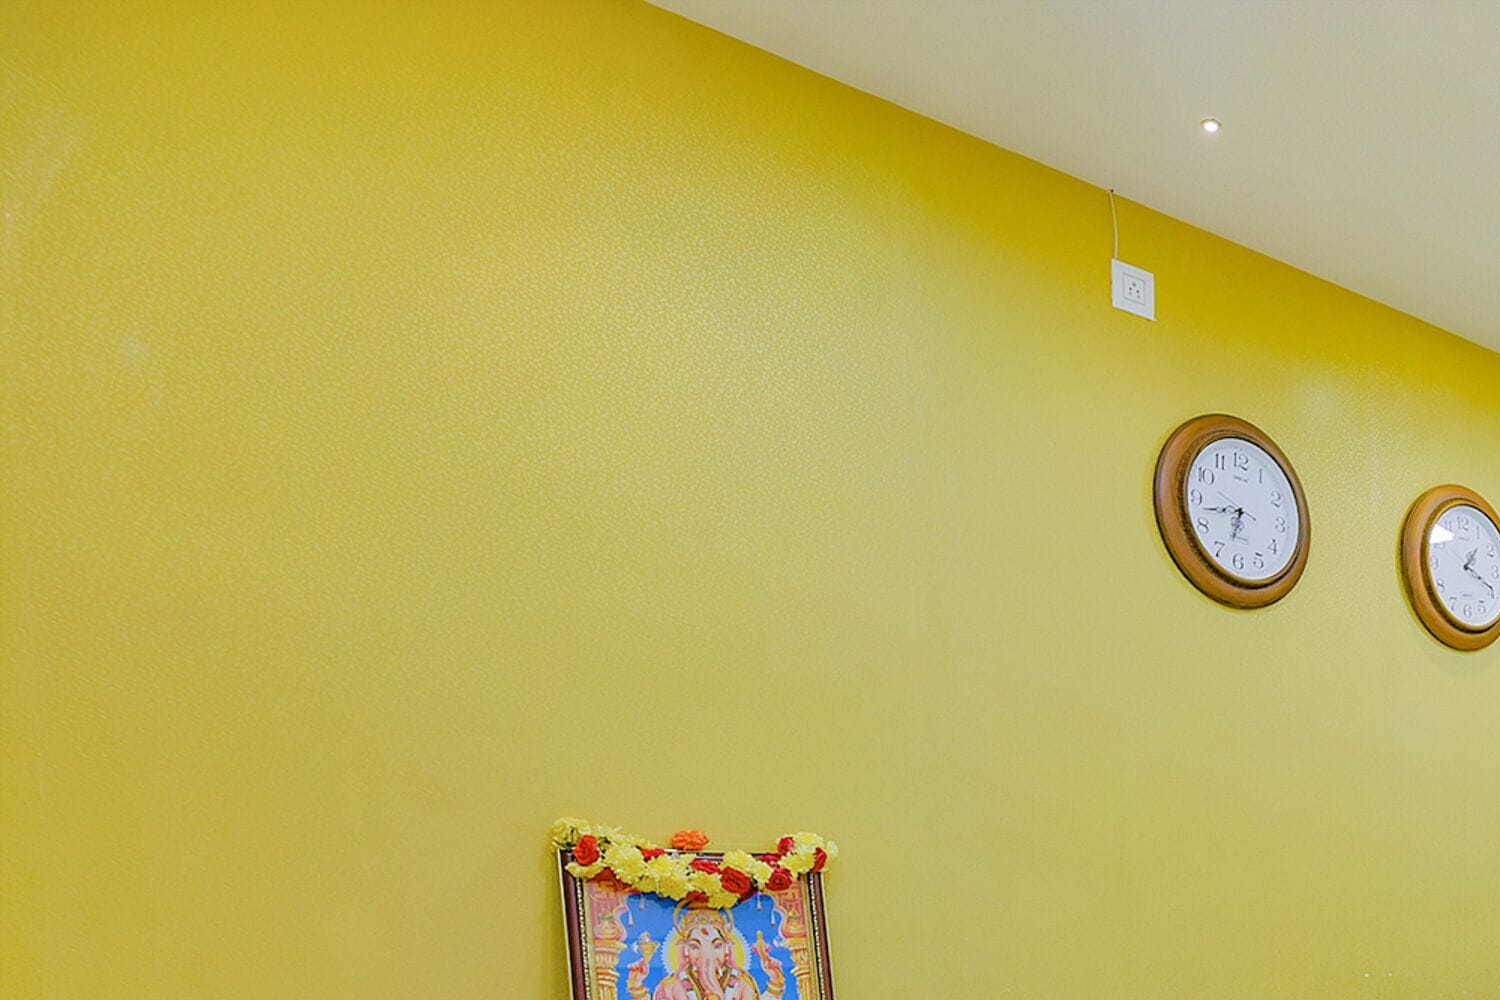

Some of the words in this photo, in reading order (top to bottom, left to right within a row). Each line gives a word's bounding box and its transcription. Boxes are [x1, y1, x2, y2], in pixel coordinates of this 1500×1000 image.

[1215, 453, 1225, 470] 11
[1233, 452, 1249, 471] 12
[1198, 467, 1214, 485] 10
[1258, 469, 1263, 483] 1
[1191, 489, 1202, 506] 9
[1271, 491, 1281, 508] 2
[1197, 517, 1209, 534] 8
[1275, 517, 1285, 533] 3
[1456, 516, 1469, 531] 12
[1214, 541, 1225, 558] 7
[1268, 539, 1278, 554] 4
[1486, 544, 1494, 557] 2
[1232, 553, 1244, 570] 6
[1253, 552, 1264, 569] 5
[1491, 565, 1499, 579] 3
[1449, 597, 1457, 611] 7
[1463, 604, 1472, 618] 6
[1478, 601, 1486, 614] 5
